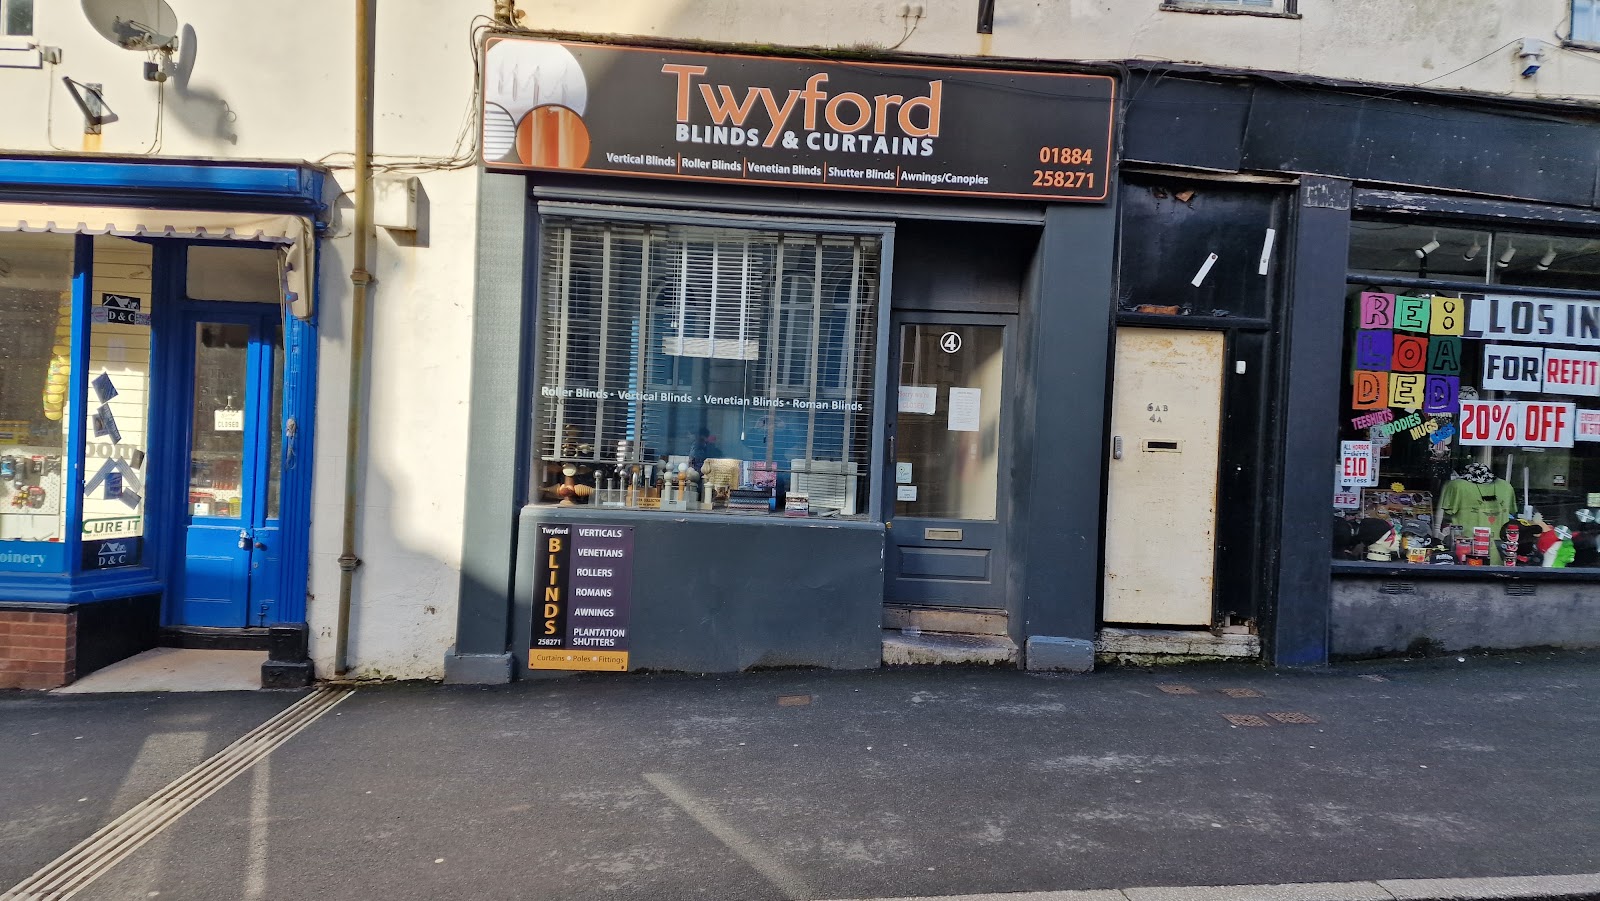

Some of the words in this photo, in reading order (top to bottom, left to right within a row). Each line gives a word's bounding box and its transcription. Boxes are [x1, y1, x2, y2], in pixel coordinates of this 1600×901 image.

[661, 63, 943, 147] Twyford
[675, 123, 759, 146] BLINDS
[781, 130, 799, 149] &
[806, 132, 934, 156] CURTAINS
[606, 152, 645, 167] Vertical
[646, 155, 676, 168] Blinds
[1039, 147, 1093, 165] 01884
[681, 157, 711, 170] Roller
[711, 159, 742, 172] Blinds
[747, 162, 791, 174] Venetian
[792, 164, 822, 176] Blinds
[828, 166, 865, 179] Shutter
[865, 168, 895, 180] Blinds
[901, 170, 989, 185] Awnings/Canopies
[1032, 170, 1095, 189] 258271
[943, 333, 958, 351] 4
[1487, 355, 1539, 382] FOR
[1547, 358, 1599, 386] REFIT
[541, 386, 574, 398] Roller
[575, 387, 609, 399] Blinds
[617, 389, 658, 402] Vertical
[660, 391, 693, 403] Blinds
[704, 394, 750, 406] Venetian
[752, 396, 785, 408] Blinds
[792, 399, 829, 410] Roman
[831, 400, 863, 412] Blinds
[1351, 408, 1394, 430] TEESHIRTS
[1462, 404, 1515, 441] 20%
[1525, 404, 1567, 443] OFF
[1409, 418, 1439, 440] MUGS
[82, 518, 123, 534] CURE
[127, 520, 140, 530] IT
[542, 527, 569, 536] Twyford
[579, 528, 622, 538] VERTICALS
[577, 548, 623, 558] VENETIANS
[576, 568, 613, 577] ROLLERS
[544, 537, 561, 635] BLINDS
[575, 588, 612, 597] ROMANS
[574, 608, 614, 617] AWNINGS
[573, 628, 625, 638] PLANTATION
[537, 638, 561, 646] 258271
[573, 638, 615, 647] SHUTTERS
[536, 654, 565, 662] Curtains
[572, 655, 591, 663] Poles
[598, 656, 624, 664] Fittings
